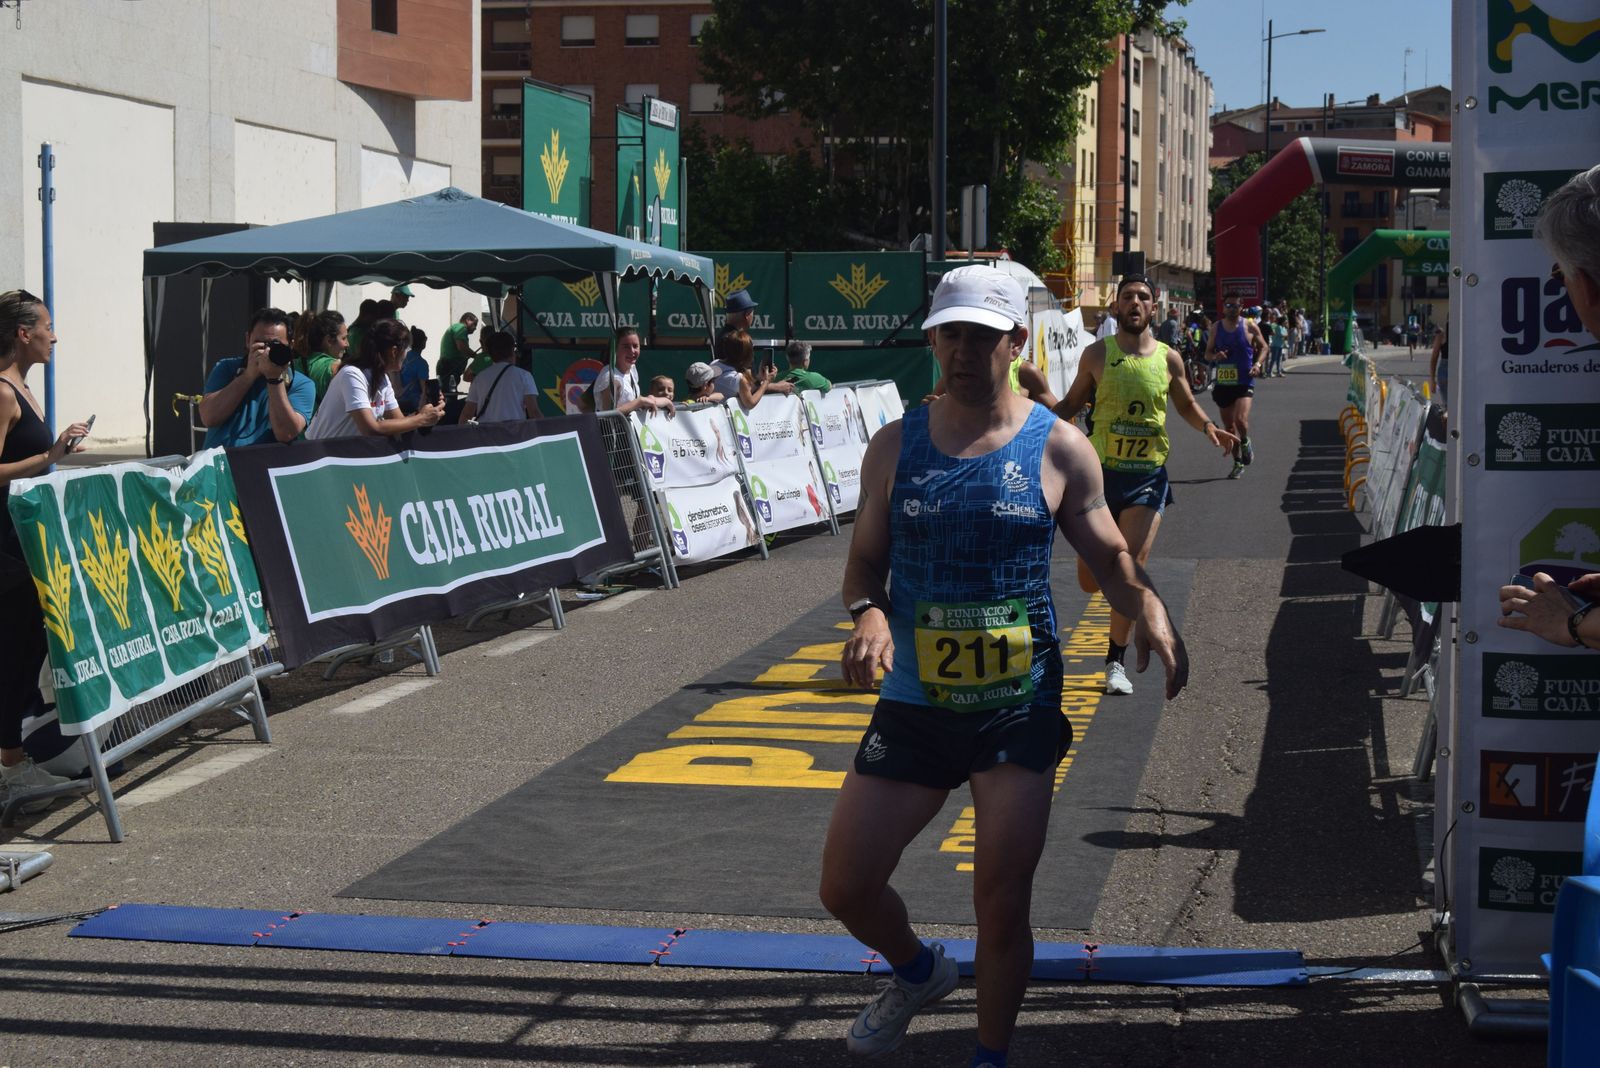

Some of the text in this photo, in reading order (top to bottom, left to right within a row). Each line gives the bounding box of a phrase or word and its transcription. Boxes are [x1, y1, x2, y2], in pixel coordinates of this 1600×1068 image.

[1406, 150, 1435, 162] CON
[1351, 162, 1391, 172] ZAMORA
[535, 312, 576, 329] CAJA
[668, 313, 707, 329] CAJA
[805, 314, 914, 331] CAJA RURAL
[1218, 369, 1237, 379] 205
[1502, 360, 1578, 375] Ganaderos
[1114, 437, 1150, 459] 172
[1546, 446, 1596, 464] CAJA
[400, 483, 565, 565] CAJA RURAL
[947, 614, 1014, 629] CAJA RURAL
[108, 633, 157, 669] CAJA RURAL
[935, 634, 1009, 679] 211
[950, 692, 981, 705] CAJA
[1543, 696, 1593, 713] CAJA
